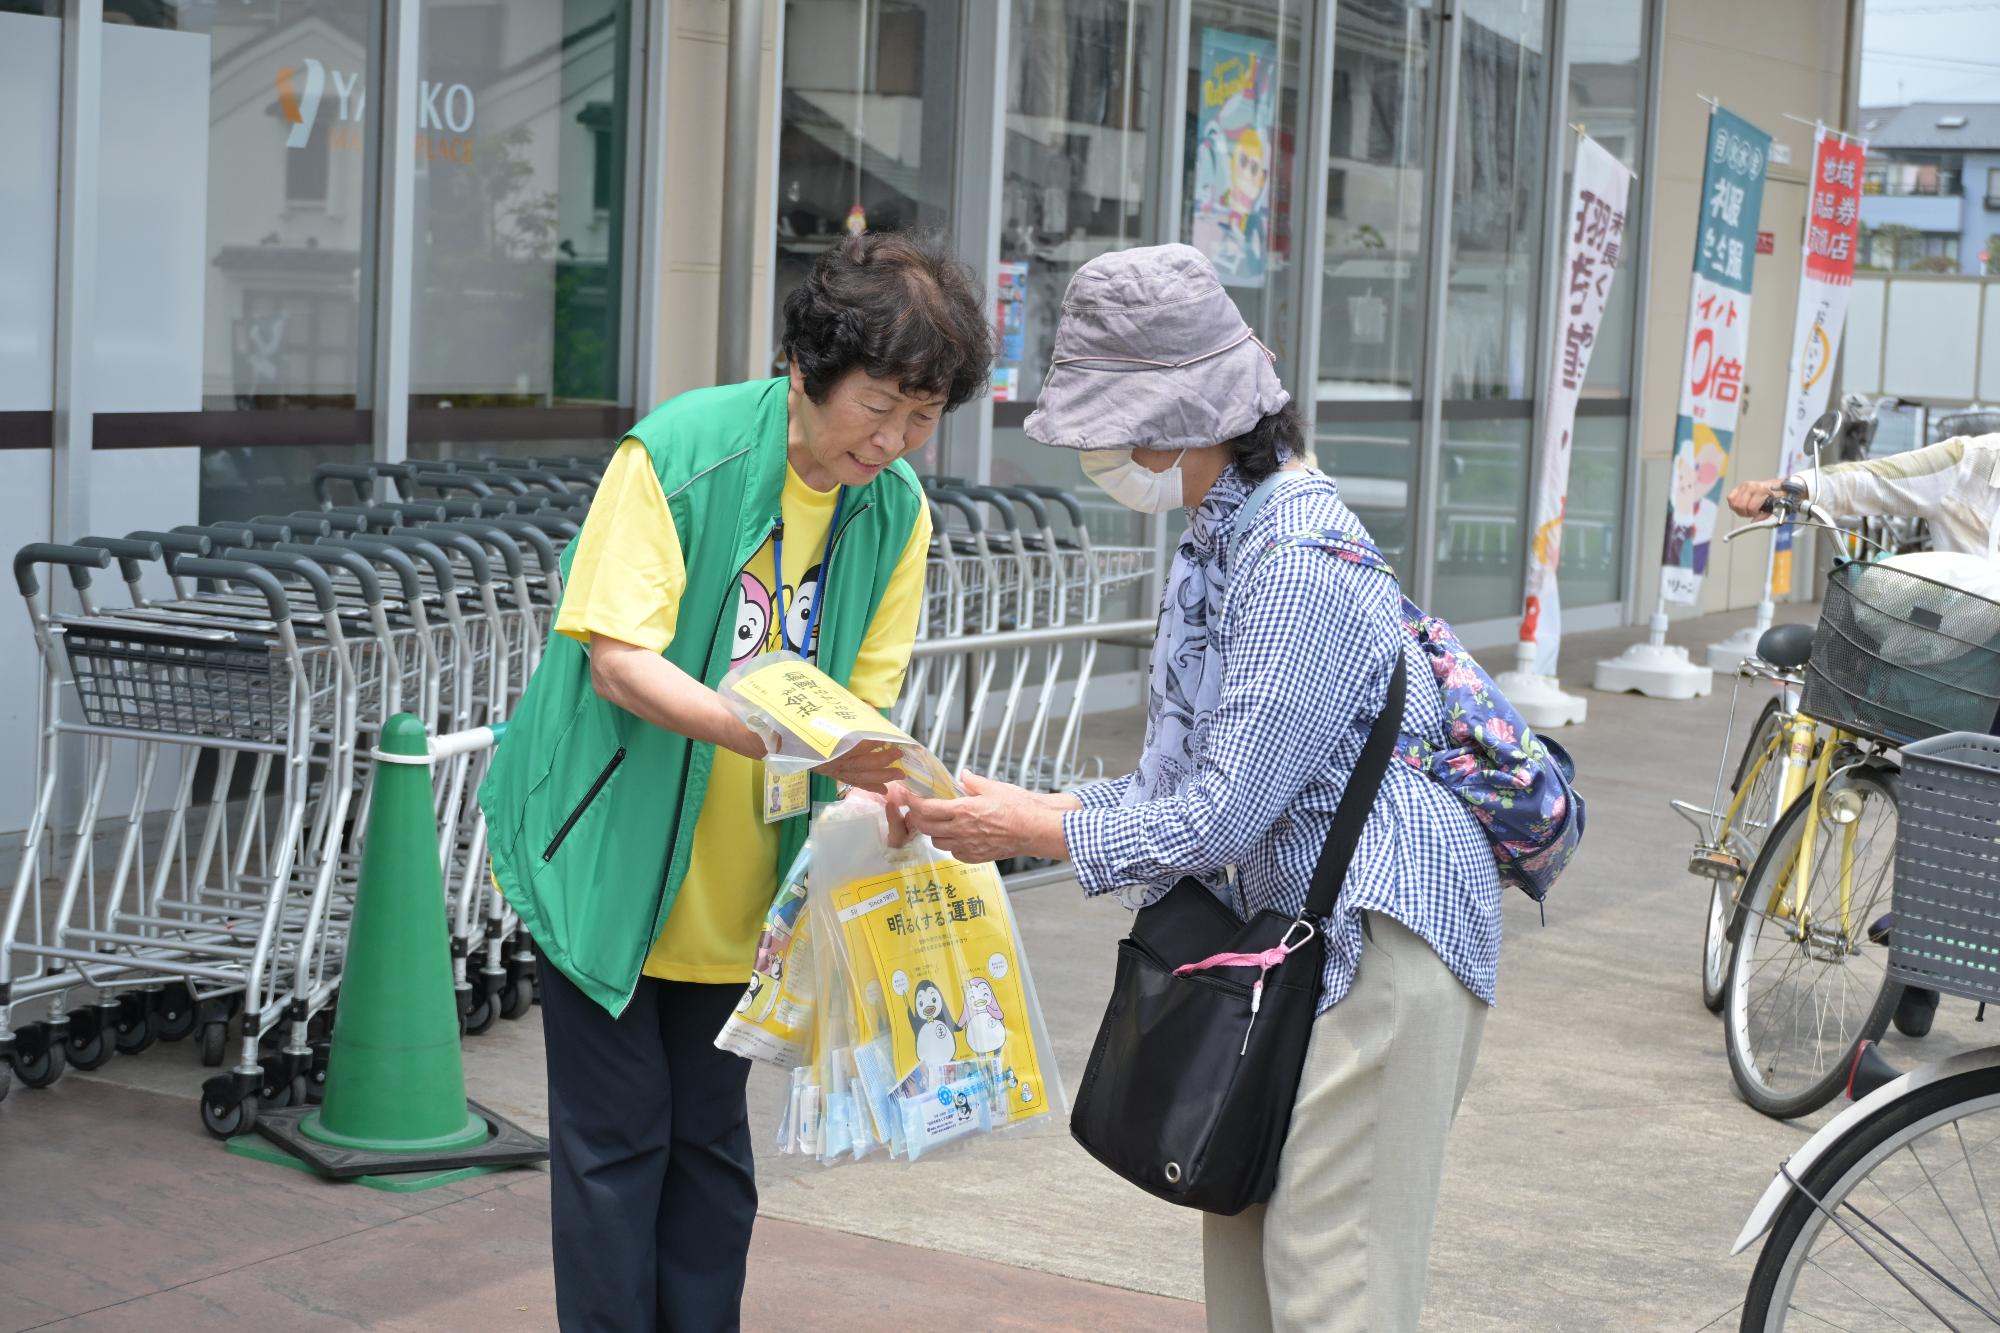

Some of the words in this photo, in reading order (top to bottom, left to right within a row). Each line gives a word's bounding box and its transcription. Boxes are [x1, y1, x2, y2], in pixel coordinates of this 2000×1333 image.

[905, 879, 957, 909] 社会を
[886, 895, 987, 936] 明るくする運動
